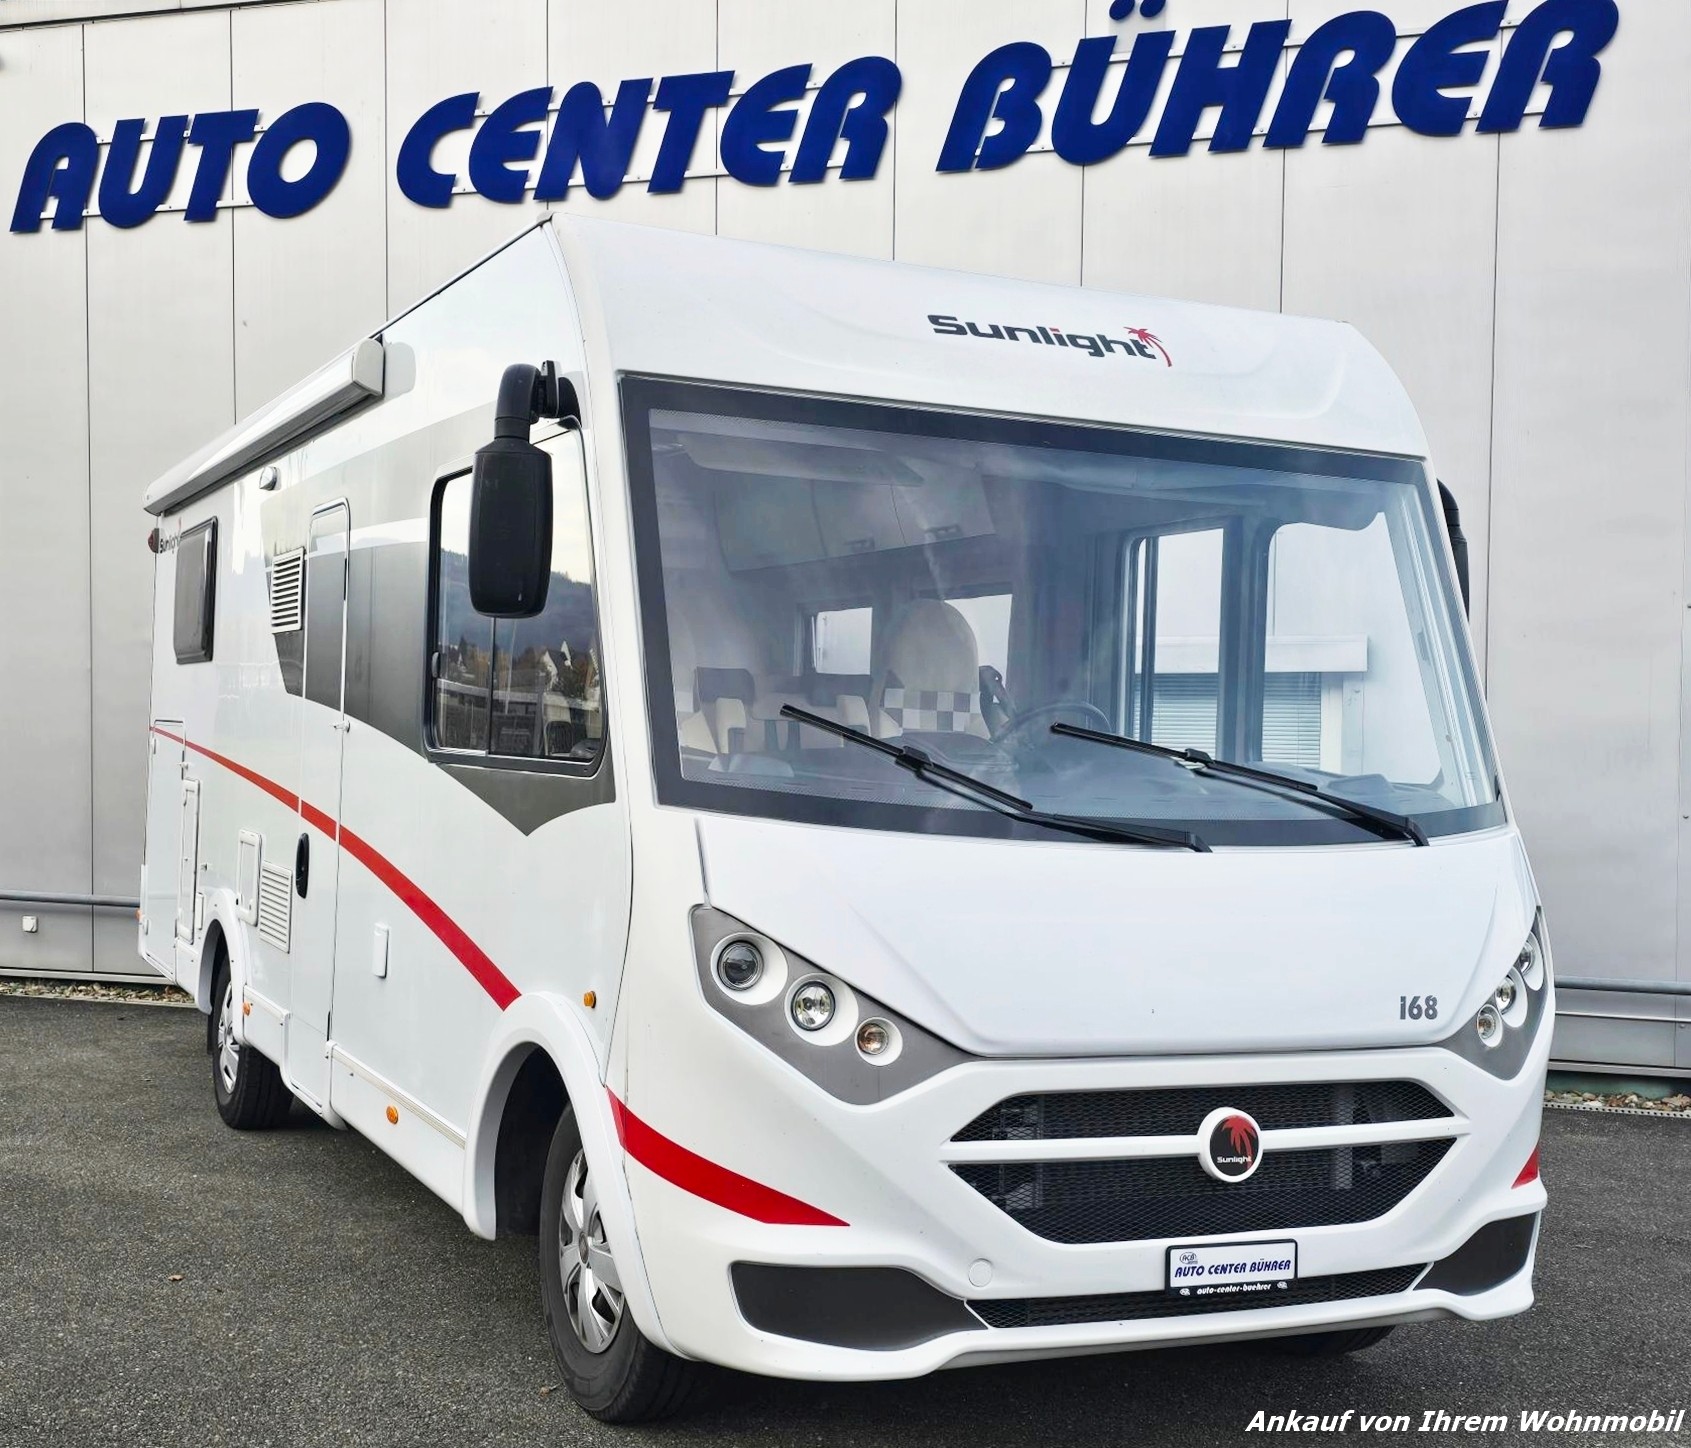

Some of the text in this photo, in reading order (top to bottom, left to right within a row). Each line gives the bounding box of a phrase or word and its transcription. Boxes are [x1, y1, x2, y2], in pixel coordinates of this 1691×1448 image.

[11, 0, 1620, 233] AUTO CENTER BÜHRER
[927, 314, 1157, 360] Sunlight
[1216, 1155, 1252, 1164] Sunlight
[1174, 1258, 1292, 1278] AUTO CENTER BÜHRER
